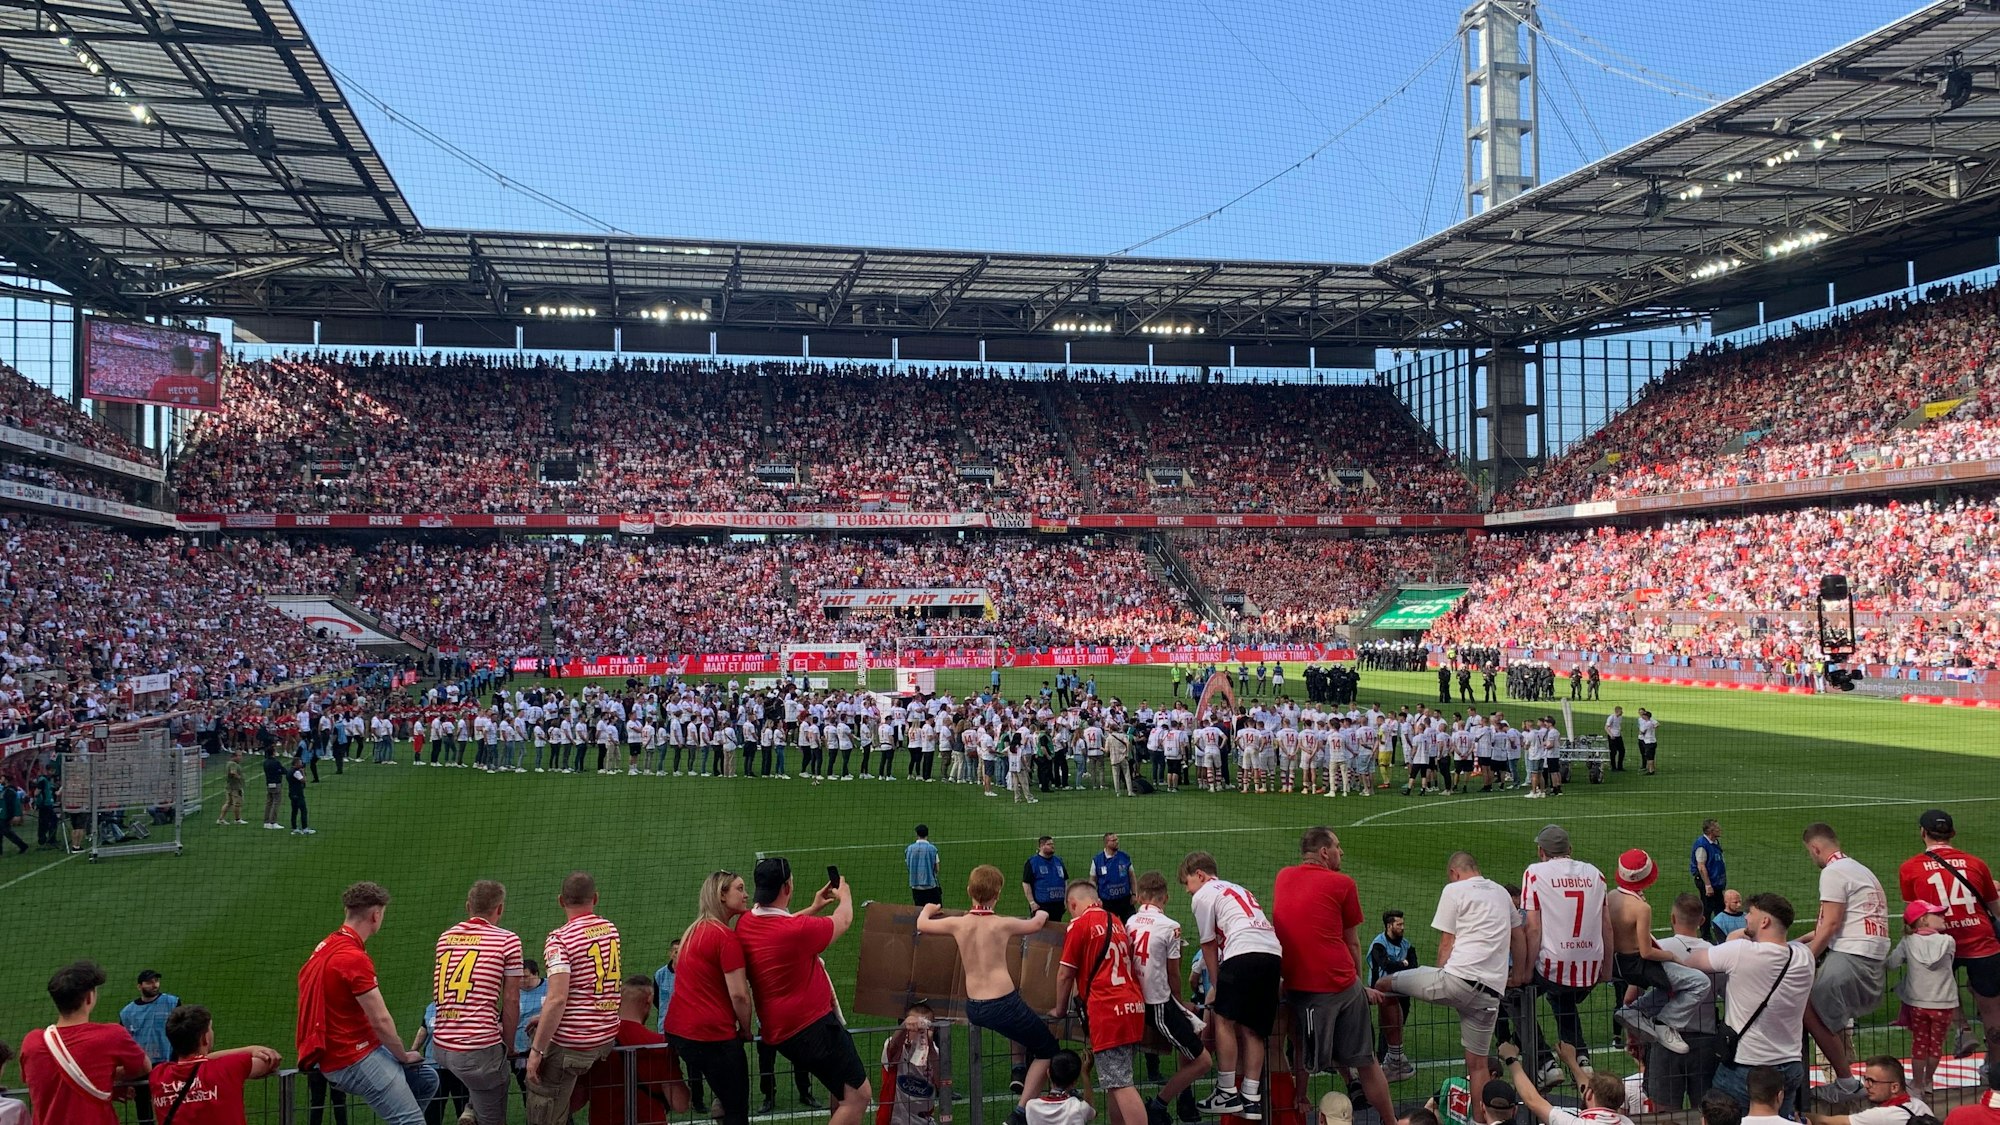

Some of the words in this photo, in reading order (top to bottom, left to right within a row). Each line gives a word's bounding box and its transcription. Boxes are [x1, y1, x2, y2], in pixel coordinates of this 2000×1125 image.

[168, 386, 199, 395] HECTOR
[295, 516, 330, 526] REWE
[368, 516, 403, 526] REWE
[493, 516, 527, 526] REWE
[567, 516, 600, 526] REWE
[676, 514, 727, 526] JONAS
[733, 515, 798, 527] HECTOR
[992, 512, 1030, 521] DANKE
[1157, 516, 1185, 525] REWE
[1216, 516, 1244, 525] REWE
[1317, 516, 1344, 525] REWE
[1375, 516, 1402, 525] REWE
[999, 520, 1026, 528] TIMO
[823, 595, 857, 606] HIT
[865, 595, 897, 605] HIT
[907, 594, 939, 605] HIT
[948, 594, 979, 604] HIT
[1054, 655, 1075, 664] MAAT
[1077, 655, 1086, 664] ET
[1088, 654, 1109, 663] JOOT!
[1169, 652, 1194, 662] DANKE
[1196, 651, 1222, 661] JONAS!
[1262, 651, 1288, 660] DANKE
[1289, 651, 1310, 659] TIMO!
[514, 658, 538, 670] ANKE
[704, 663, 728, 672] MAAT
[729, 662, 739, 671] ET
[741, 661, 765, 671] JOOT!
[844, 659, 870, 669] DANE
[873, 658, 897, 668] JONAS
[973, 657, 993, 666] TIMO
[583, 665, 606, 675] MAAT
[609, 665, 620, 675] ET
[622, 664, 647, 674] JOOT!
[965, 735, 973, 744] 14
[1087, 733, 1096, 742] 14
[1207, 732, 1215, 742] 14
[1245, 733, 1254, 743] 14
[1286, 733, 1294, 743] 14
[1305, 735, 1314, 745] 14
[1459, 735, 1467, 746] 14
[1332, 739, 1341, 749] 14
[1923, 858, 1967, 871] HECTOR
[1926, 870, 1978, 917] 14
[1223, 888, 1263, 918] 14
[1564, 890, 1585, 938] 7
[1136, 917, 1155, 925] HECTOR
[1951, 921, 1960, 929] FC
[1960, 918, 1981, 927] KÖLN
[445, 935, 482, 946] HECTOR
[1576, 940, 1593, 949] KÖLN
[1130, 929, 1151, 966] 14
[586, 938, 621, 995] 14
[436, 949, 480, 1005] 14
[1114, 1005, 1123, 1016] 1.
[1124, 1003, 1135, 1014] FC
[902, 1082, 930, 1096] Ford
[153, 1085, 218, 1107] AUFFESSEN
